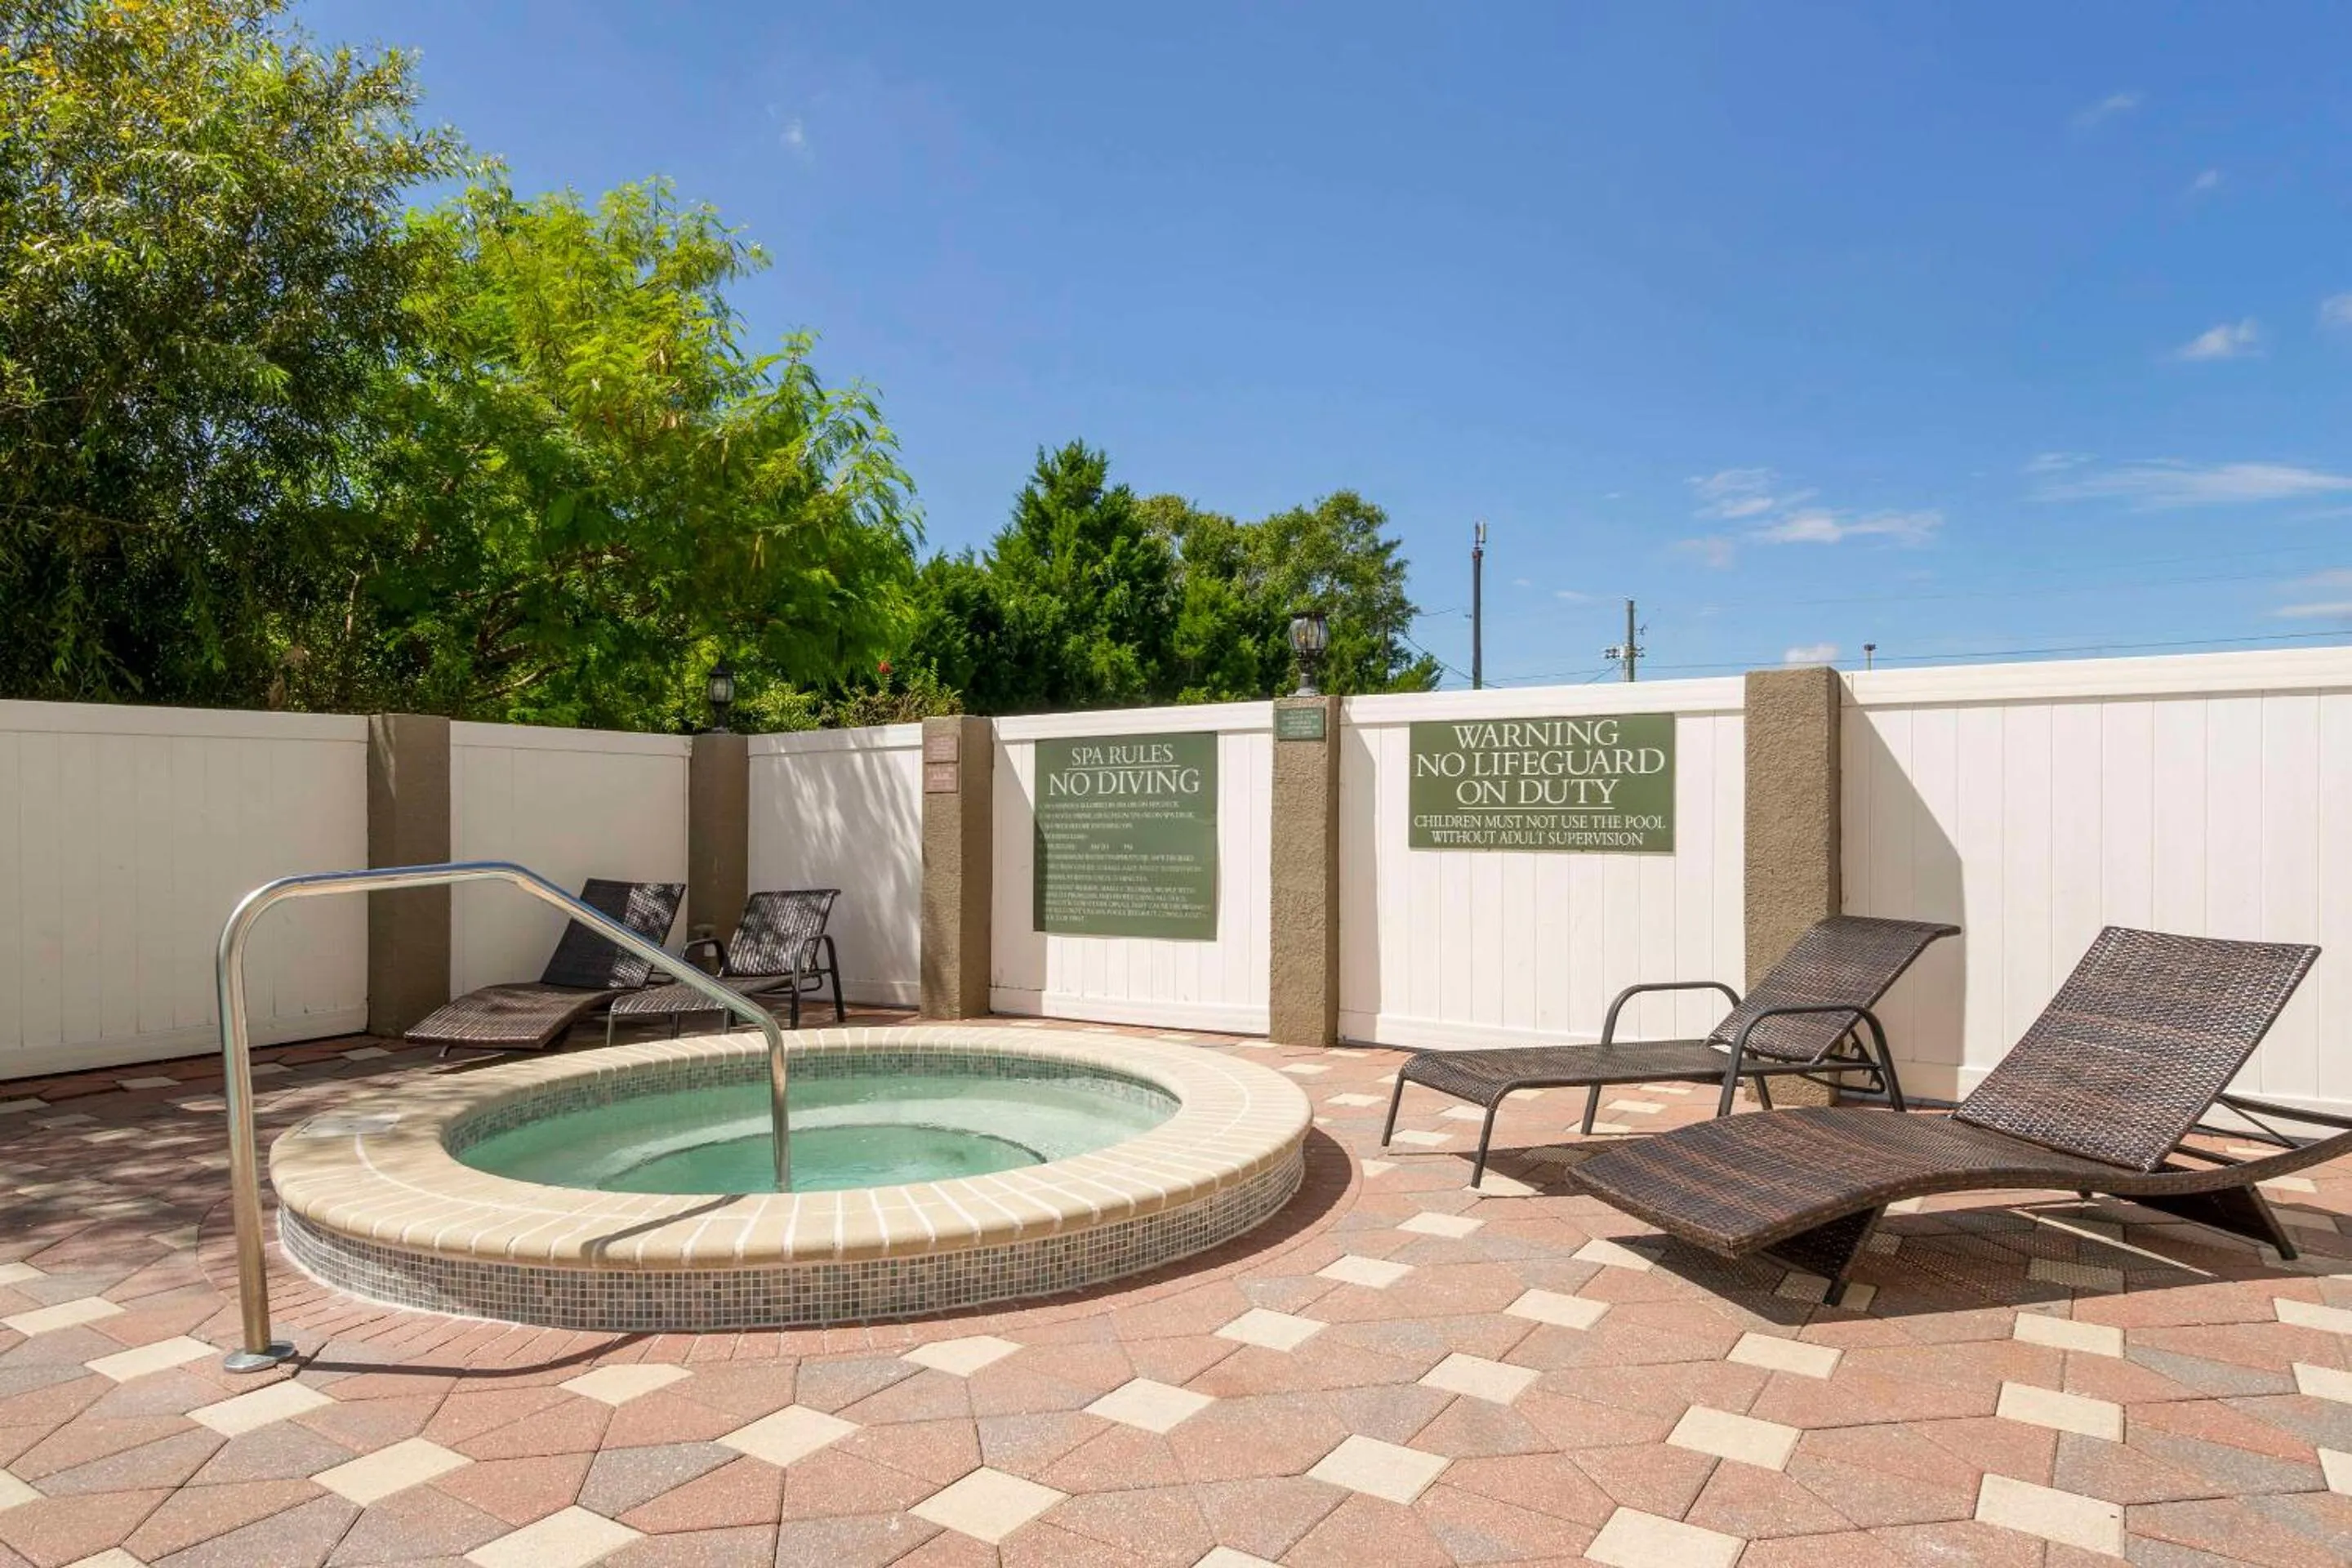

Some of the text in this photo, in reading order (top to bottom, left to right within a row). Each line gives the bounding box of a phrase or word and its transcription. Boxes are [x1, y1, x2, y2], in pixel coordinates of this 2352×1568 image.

[1452, 719, 1619, 749] WARNING
[1071, 744, 1174, 766] SPA RULES
[1416, 748, 1666, 777] NO LIFEGUARD
[1049, 768, 1200, 796] NO DIVING
[1456, 778, 1619, 805] ON DUTY
[1414, 815, 1666, 829] CHILDREN MUST NOT USE THE POOL
[1431, 831, 1644, 846] WITHOUT ADULT SUPERVISION
